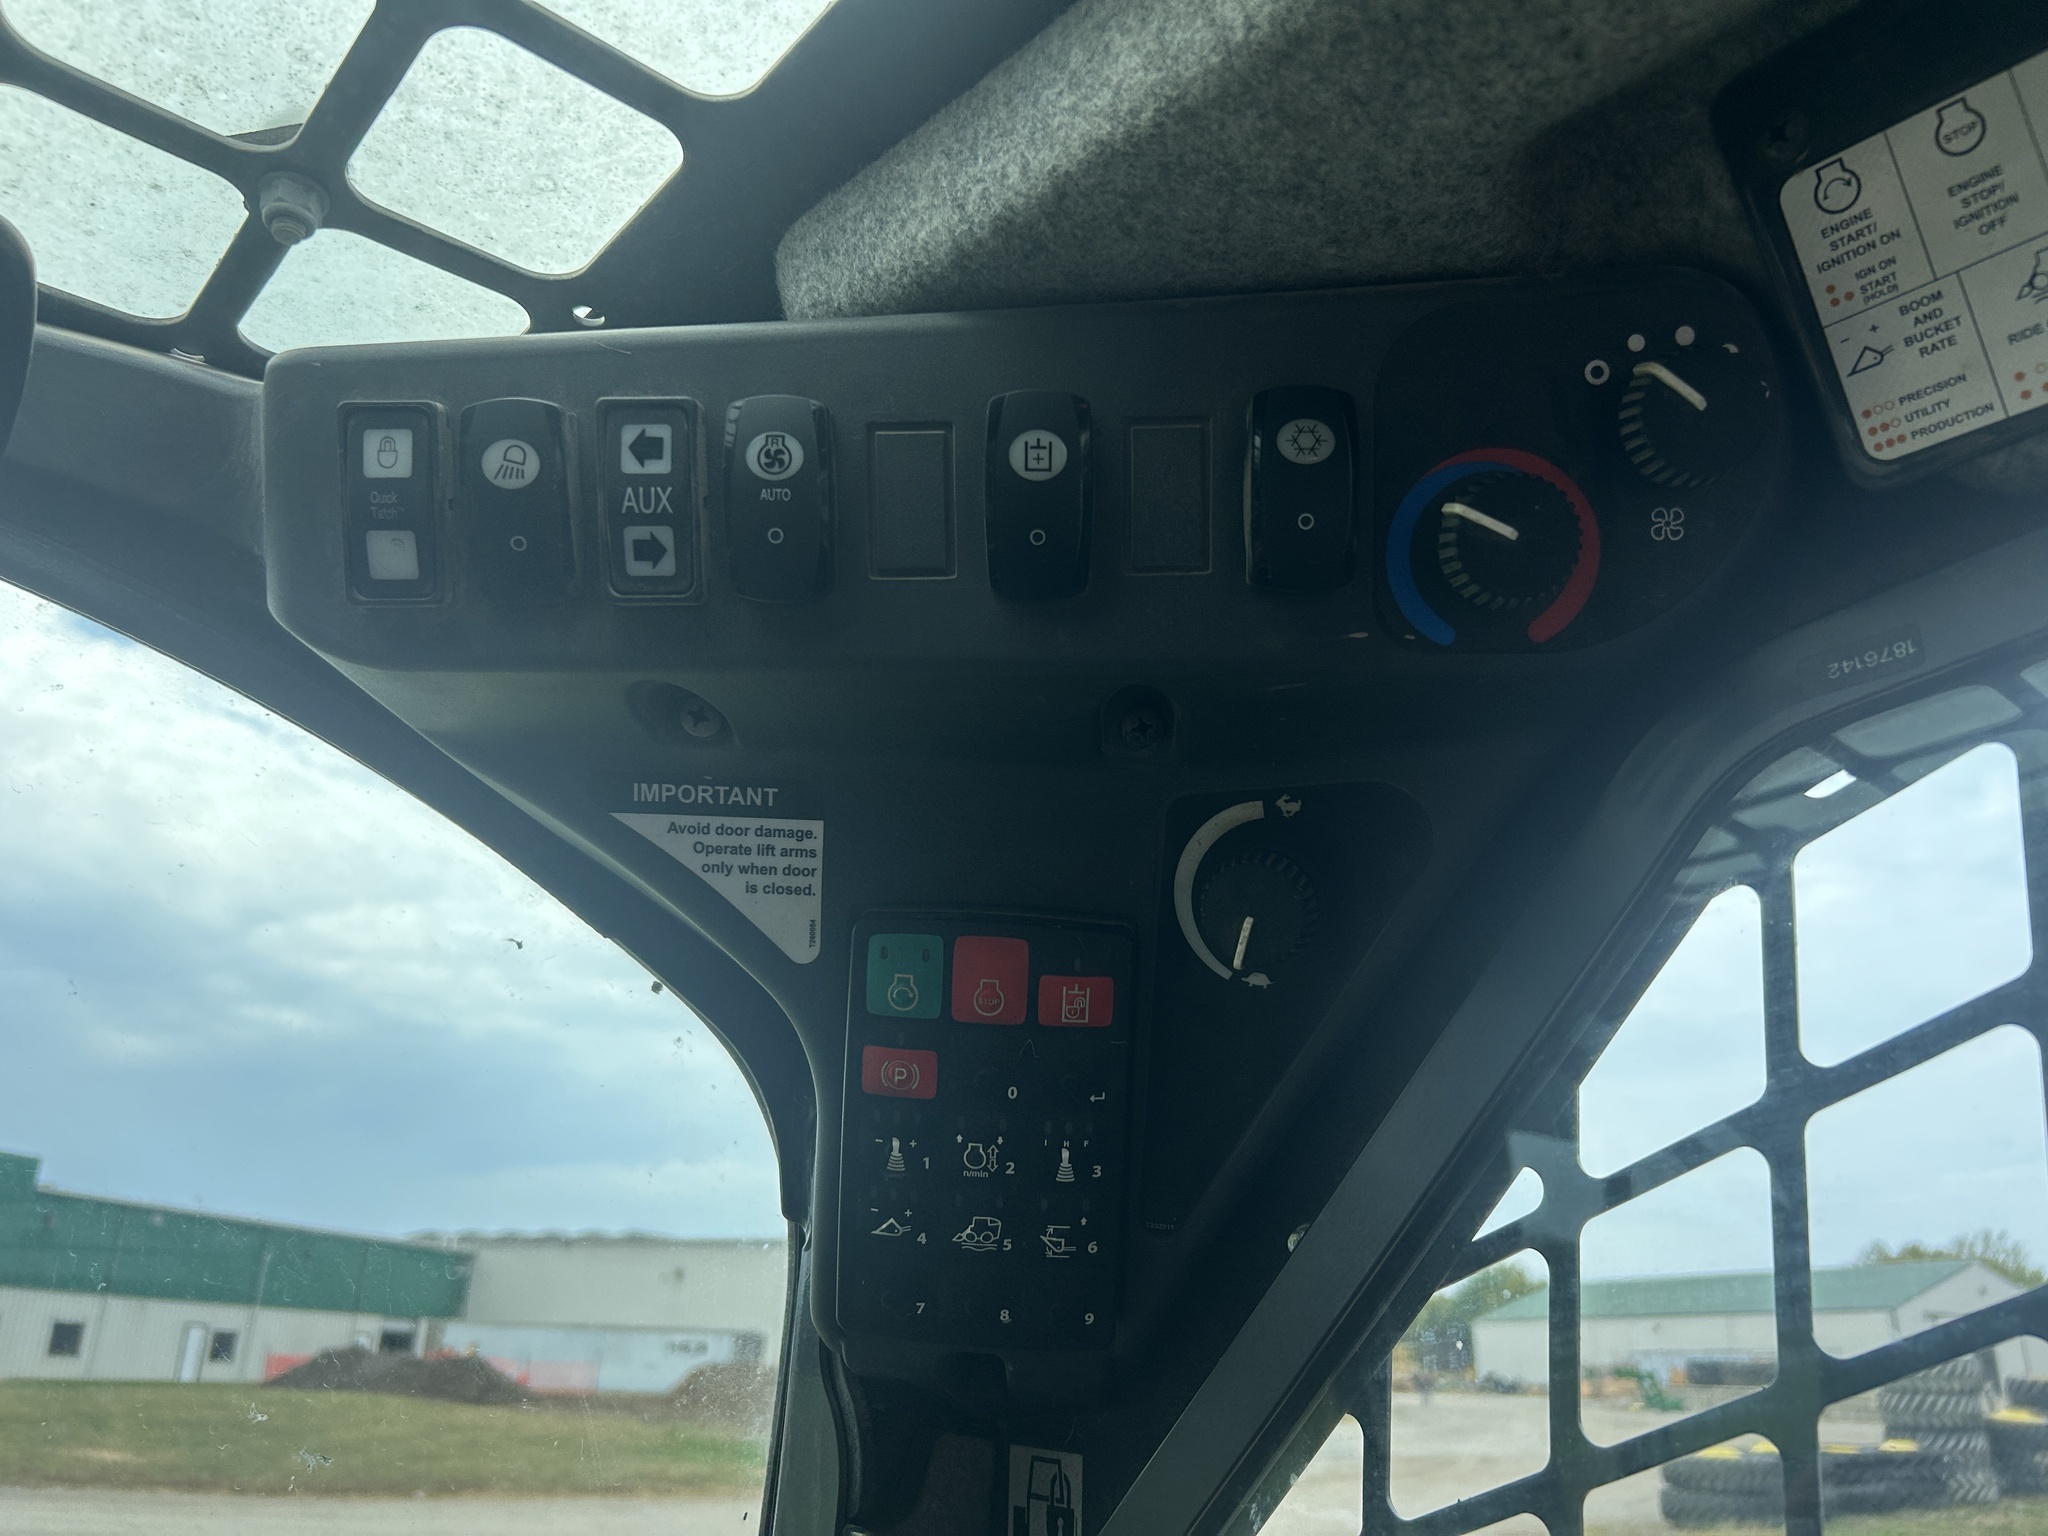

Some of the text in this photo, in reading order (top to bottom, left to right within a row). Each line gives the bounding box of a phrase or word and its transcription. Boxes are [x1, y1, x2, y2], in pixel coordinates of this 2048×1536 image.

[1943, 120, 1977, 145] STOP
[1947, 163, 2003, 198] ENGINE
[1960, 181, 2005, 209] STOP/
[1953, 193, 2019, 230] IGNITION
[1821, 208, 1873, 239] ENGINE
[1978, 215, 2007, 236] OFF
[1830, 223, 1878, 252] START/
[1817, 229, 1901, 274] IGNITION ON
[1855, 256, 1896, 281] IGN ON
[1860, 271, 1897, 295] START
[1863, 283, 1899, 305] (HOLD)
[1899, 290, 1944, 317] BOOM
[1913, 308, 1944, 327] AND
[1904, 316, 1962, 348] BUCKET
[2007, 322, 2045, 345] RIDE
[1919, 335, 1957, 358] RATE
[1898, 373, 1967, 407] PRECISION
[1904, 398, 1951, 424] UTILITY
[1910, 402, 1994, 440] PRODUCTION
[370, 491, 398, 504] Quick
[622, 486, 674, 515] AUX
[760, 488, 791, 502] AUTO
[1827, 639, 1917, 679] 1876142
[633, 782, 778, 806] IMPORTANT
[667, 821, 818, 842] Avoid door damage.
[693, 841, 817, 858] Operate lift arms
[701, 861, 818, 877] only when door
[745, 881, 816, 896] is closed.
[978, 997, 1000, 1006] STOP
[894, 1067, 907, 1085] P
[1007, 1086, 1018, 1100] 0
[922, 1156, 930, 1170] 1
[1005, 1161, 1016, 1175] 2
[1091, 1165, 1102, 1178] 3
[963, 1169, 989, 1179] n/min
[916, 1232, 927, 1245] 4
[1002, 1238, 1012, 1251] 5
[1087, 1241, 1098, 1254] 6
[915, 1302, 926, 1315] 7
[999, 1309, 1010, 1322] 8
[1084, 1312, 1095, 1325] 9
